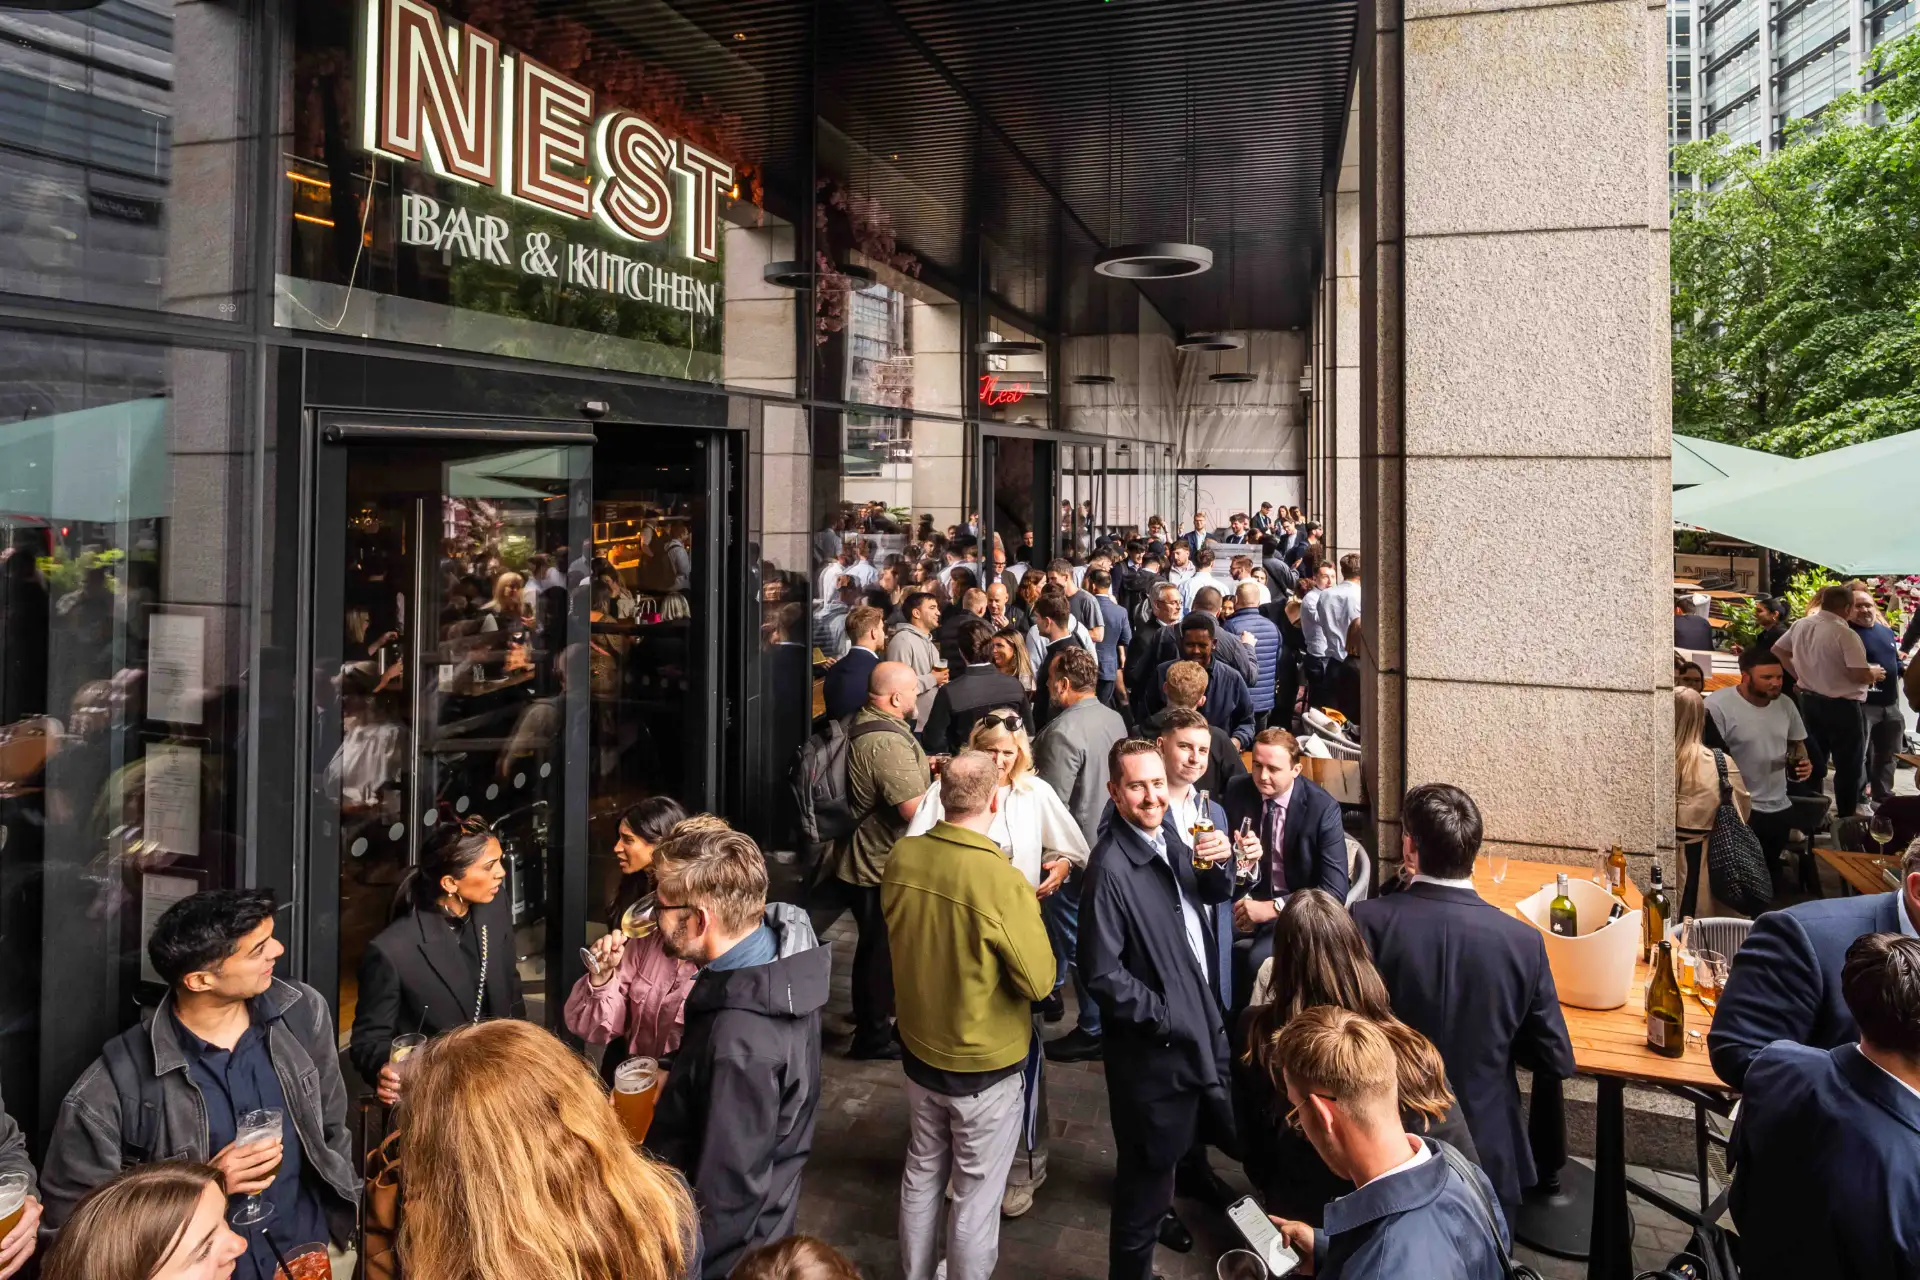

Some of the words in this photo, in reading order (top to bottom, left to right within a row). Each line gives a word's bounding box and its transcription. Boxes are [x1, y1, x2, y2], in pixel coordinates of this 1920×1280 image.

[368, 0, 735, 262] NEST
[402, 193, 511, 265] BAR
[521, 232, 558, 278] &
[569, 243, 715, 317] KITCHEN
